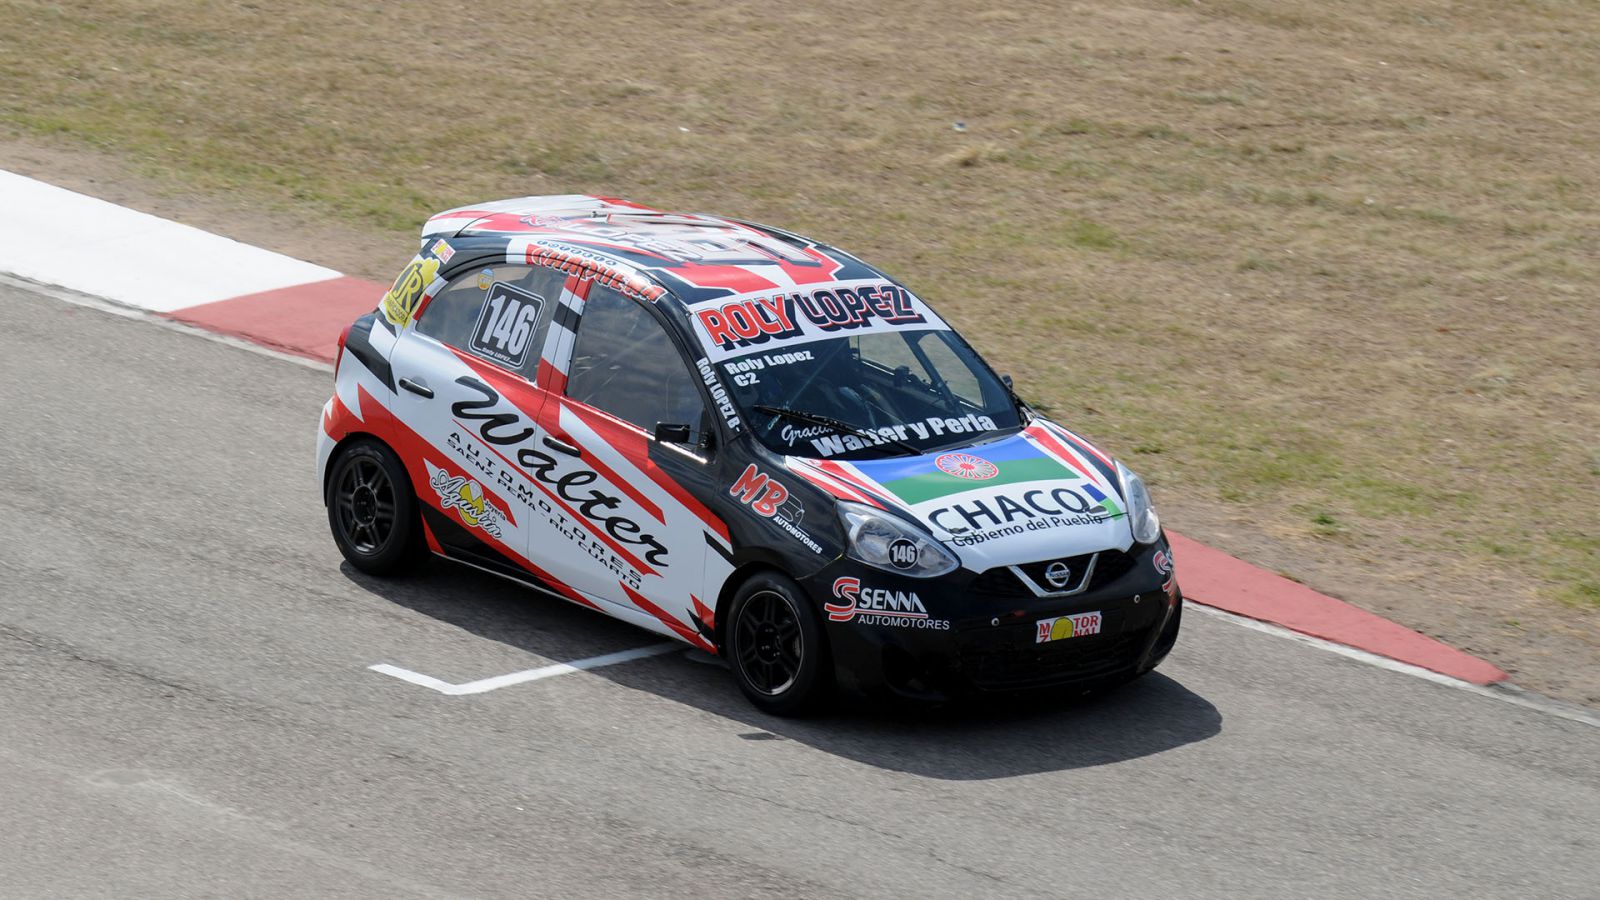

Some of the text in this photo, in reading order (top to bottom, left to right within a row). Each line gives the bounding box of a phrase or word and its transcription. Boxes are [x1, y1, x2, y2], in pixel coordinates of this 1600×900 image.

[481, 294, 536, 356] 146
[698, 285, 925, 350] ROLY LOPEZ
[724, 350, 814, 375] Roly Lopez
[733, 372, 760, 387] C2
[696, 357, 717, 386] Roly
[709, 383, 736, 419] LOPEZ
[907, 422, 930, 440] y
[926, 413, 998, 436] Perla
[451, 375, 669, 567] Walter
[730, 463, 789, 518] MB
[447, 438, 494, 478] SAENZ
[549, 518, 574, 540] RIO
[578, 541, 640, 590] CUARTO
[449, 431, 642, 583] AUTOMOTORES
[928, 488, 1091, 535] CHACO
[773, 515, 823, 554] AUTOMOTORES
[952, 513, 1104, 548] Gobierno del Pueblo
[890, 544, 916, 563] 146
[860, 587, 927, 613] SENNA
[858, 614, 950, 631] AUTOMOTORES
[1039, 615, 1099, 635] MTOR
